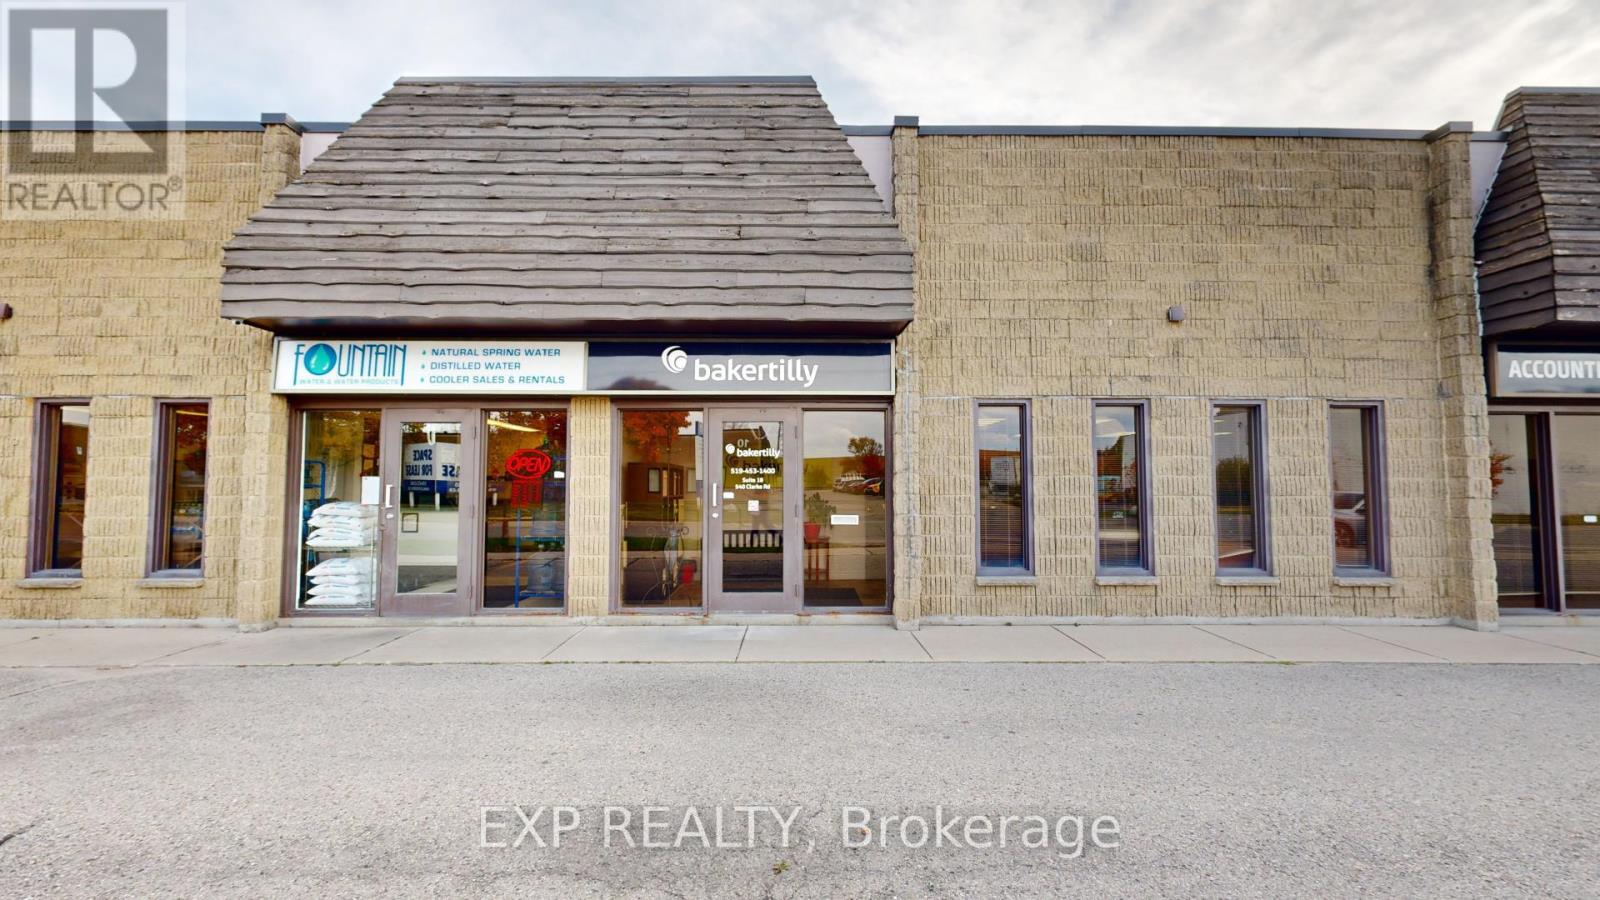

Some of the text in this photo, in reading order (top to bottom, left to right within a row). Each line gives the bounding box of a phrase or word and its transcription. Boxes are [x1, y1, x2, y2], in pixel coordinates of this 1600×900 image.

[431, 348, 561, 357] NATURAL SPRING WATER
[293, 343, 407, 386] FOUNTAIN
[430, 361, 521, 370] DISTILLED WATER
[694, 358, 819, 387] bakertilly
[429, 375, 565, 384] COOLER SALES & RENTALS
[736, 448, 781, 459] bakertilly
[507, 455, 547, 473] OPEN
